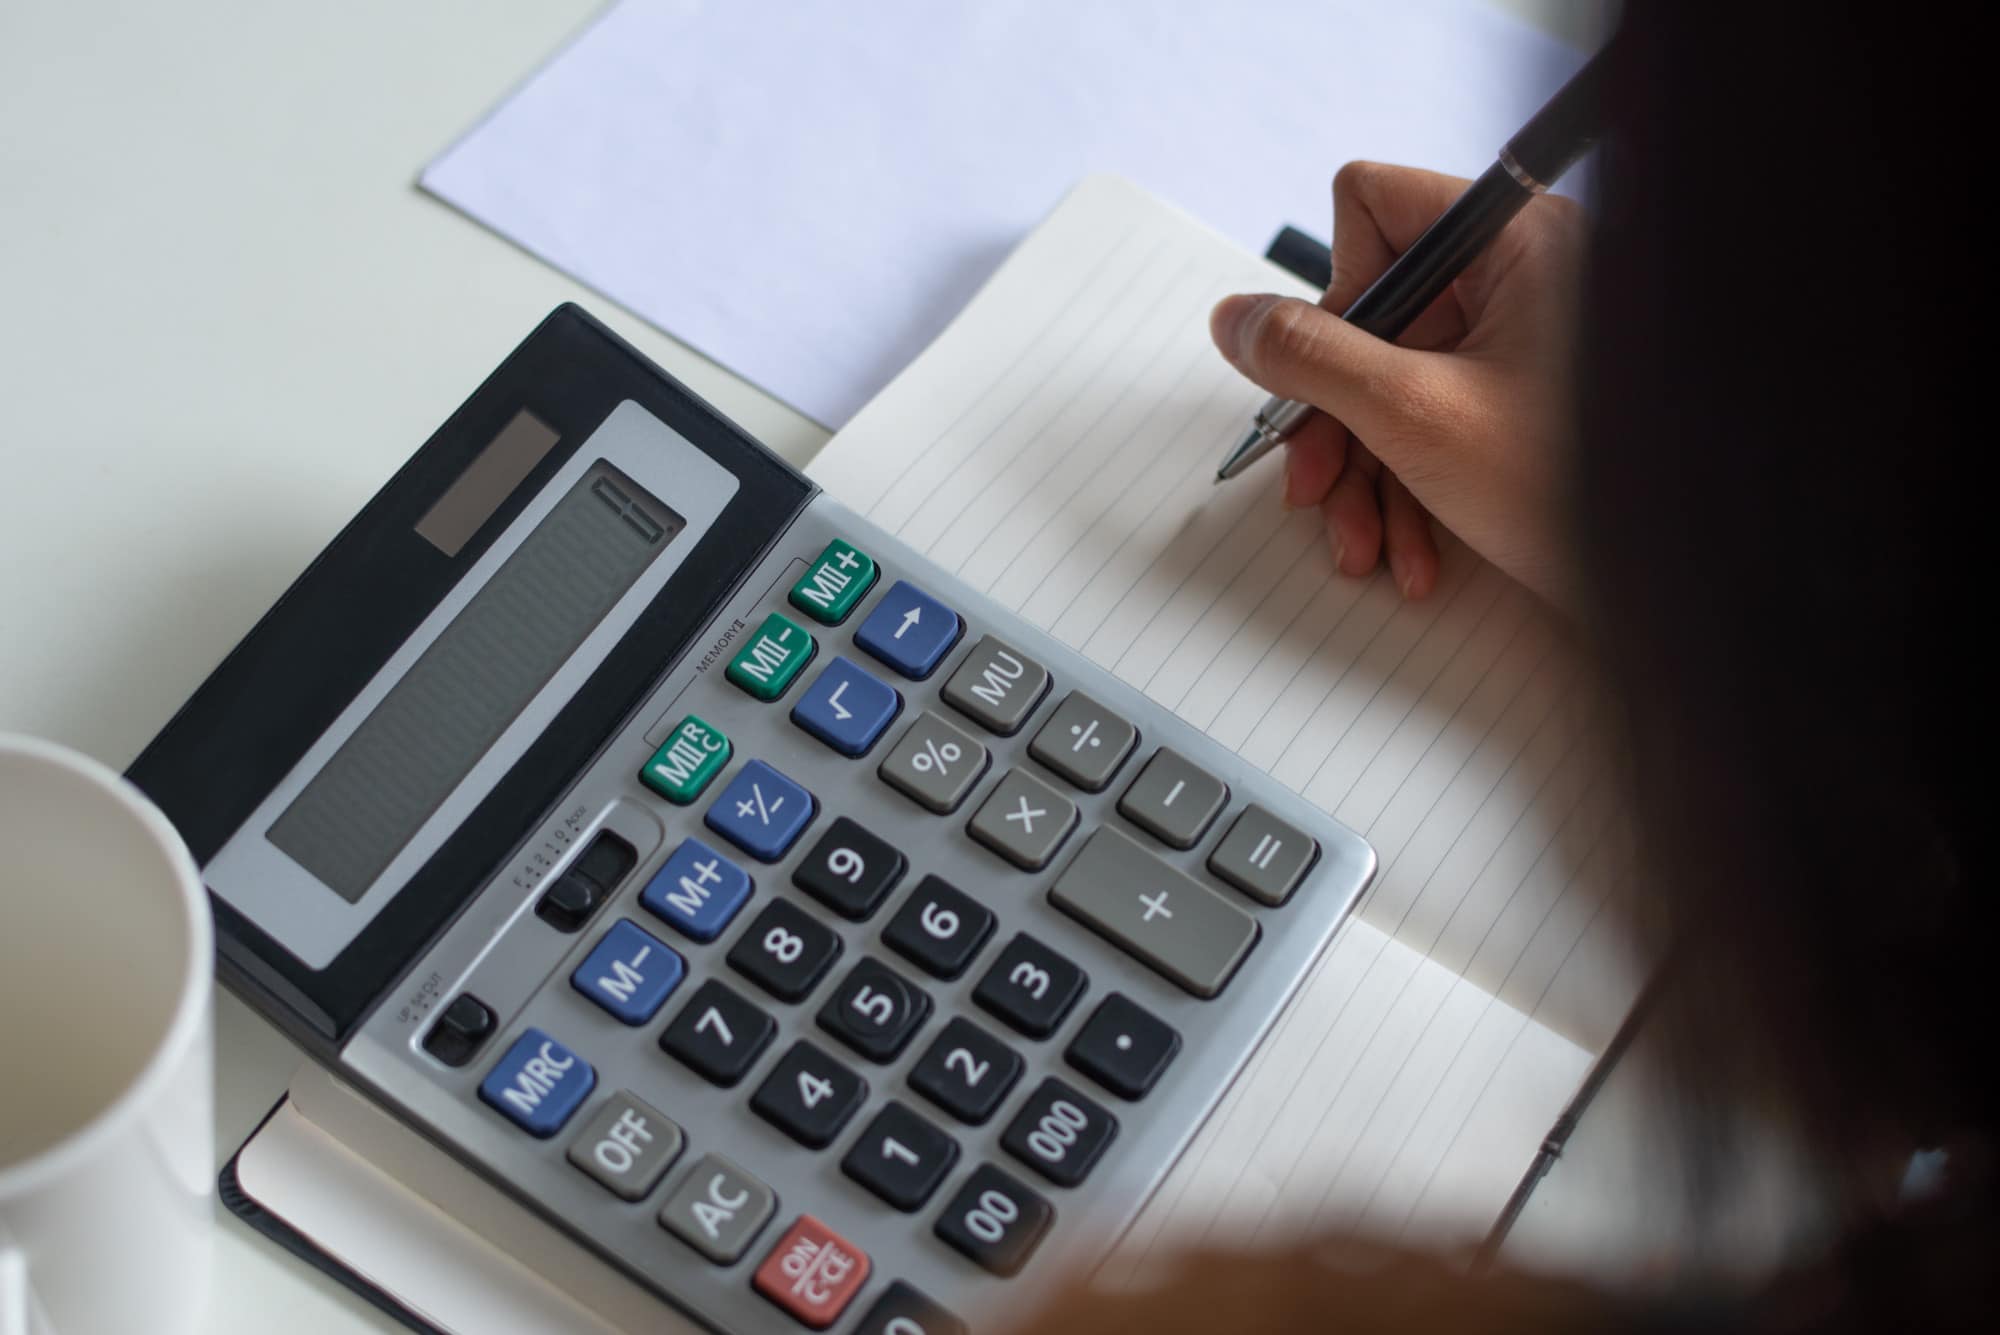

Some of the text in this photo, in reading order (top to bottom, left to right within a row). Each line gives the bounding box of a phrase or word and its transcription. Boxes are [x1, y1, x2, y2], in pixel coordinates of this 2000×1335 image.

[970, 650, 1024, 707] MU
[827, 847, 865, 883] 9
[666, 859, 722, 916] M+
[921, 902, 960, 939] 6
[763, 927, 804, 963] 8
[598, 946, 650, 1002] M-
[1009, 961, 1050, 999] 3
[852, 986, 893, 1025] 5
[695, 1007, 733, 1045] 7
[503, 1040, 575, 1115] MRC
[945, 1048, 989, 1086] 2
[798, 1071, 833, 1107] 4
[594, 1109, 653, 1173] OFF
[883, 1137, 919, 1164] 1
[1027, 1100, 1088, 1163] 000
[692, 1174, 748, 1237] AC
[965, 1190, 1018, 1242] 00
